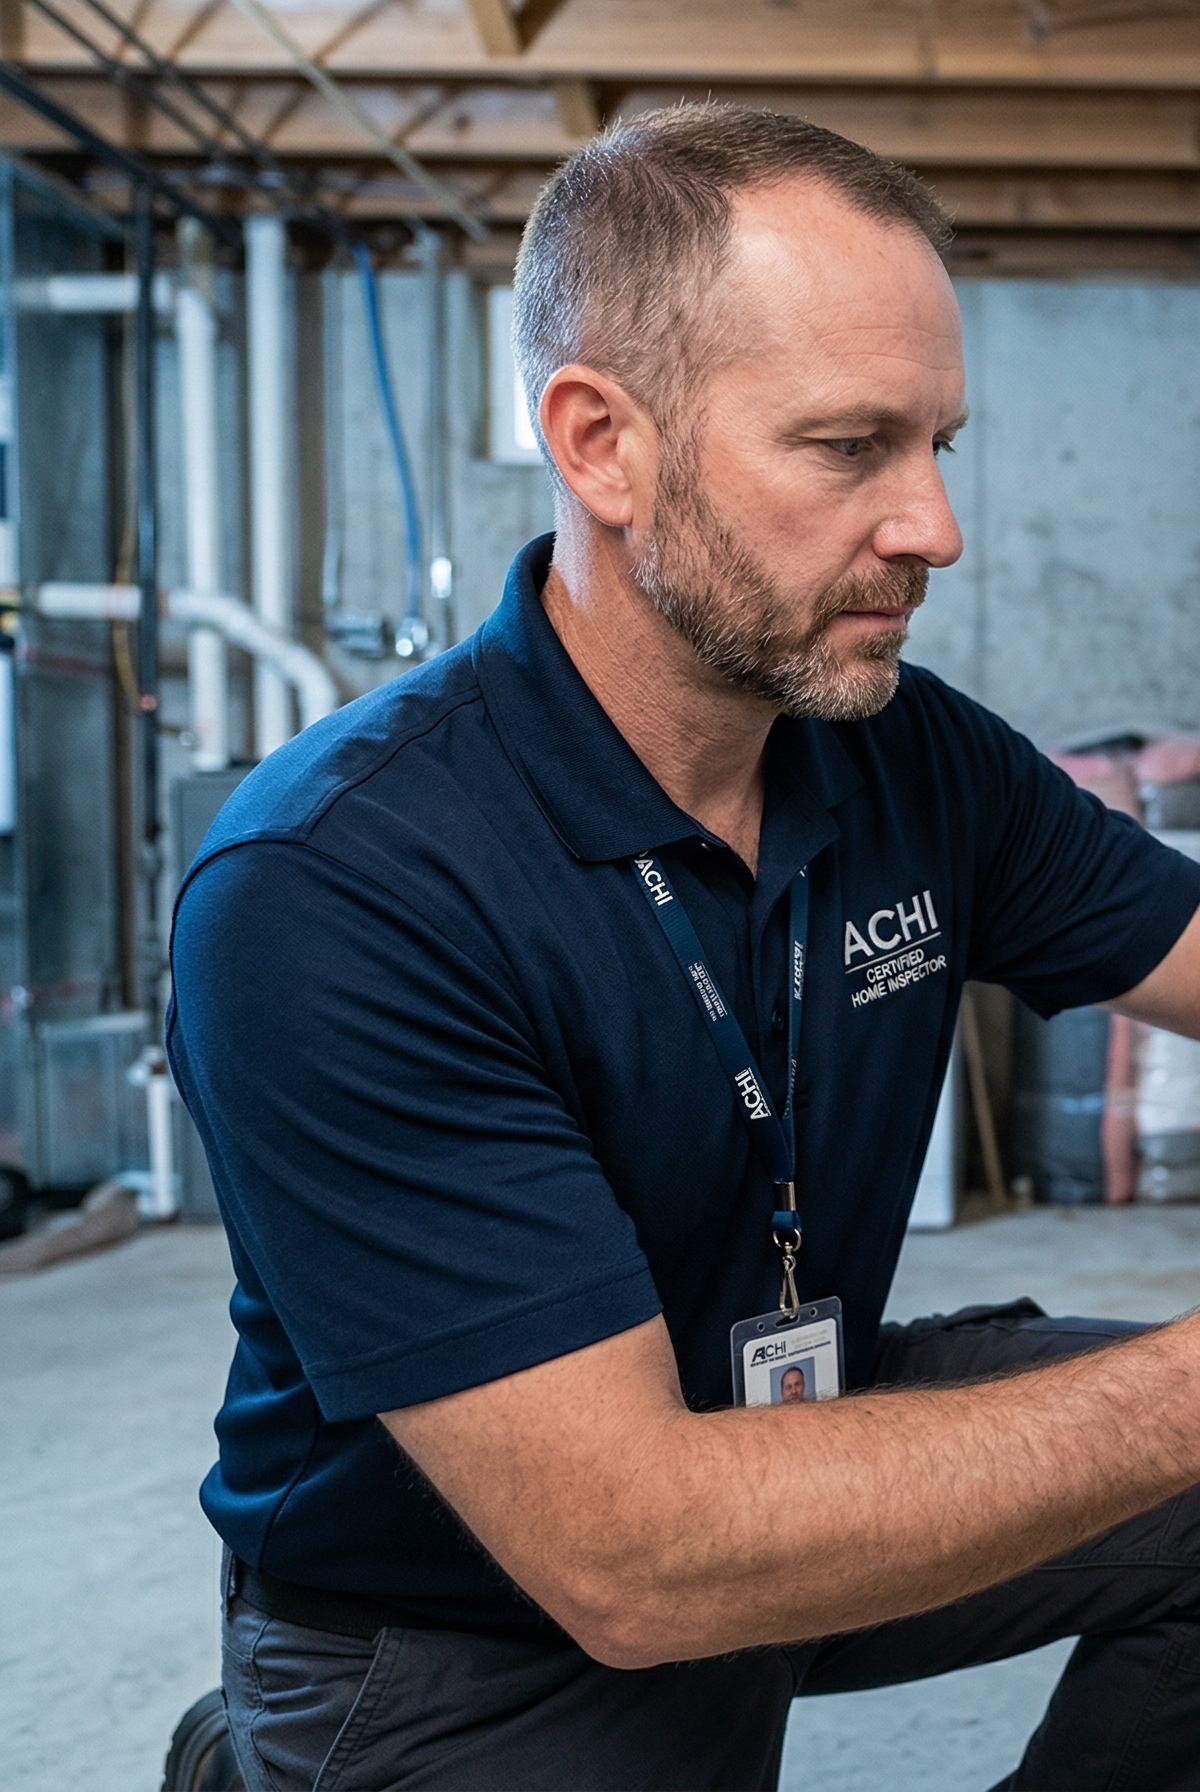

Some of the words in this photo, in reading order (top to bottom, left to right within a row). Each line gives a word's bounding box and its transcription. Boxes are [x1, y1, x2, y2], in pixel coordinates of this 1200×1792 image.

[634, 859, 673, 906] ACHI
[845, 890, 939, 966] ACHI
[851, 981, 888, 1008] HOME
[887, 955, 947, 992] INSPECTOR
[866, 948, 925, 984] CERTIFIED
[734, 1068, 769, 1120] ACHI
[751, 1340, 786, 1363] ACHI
